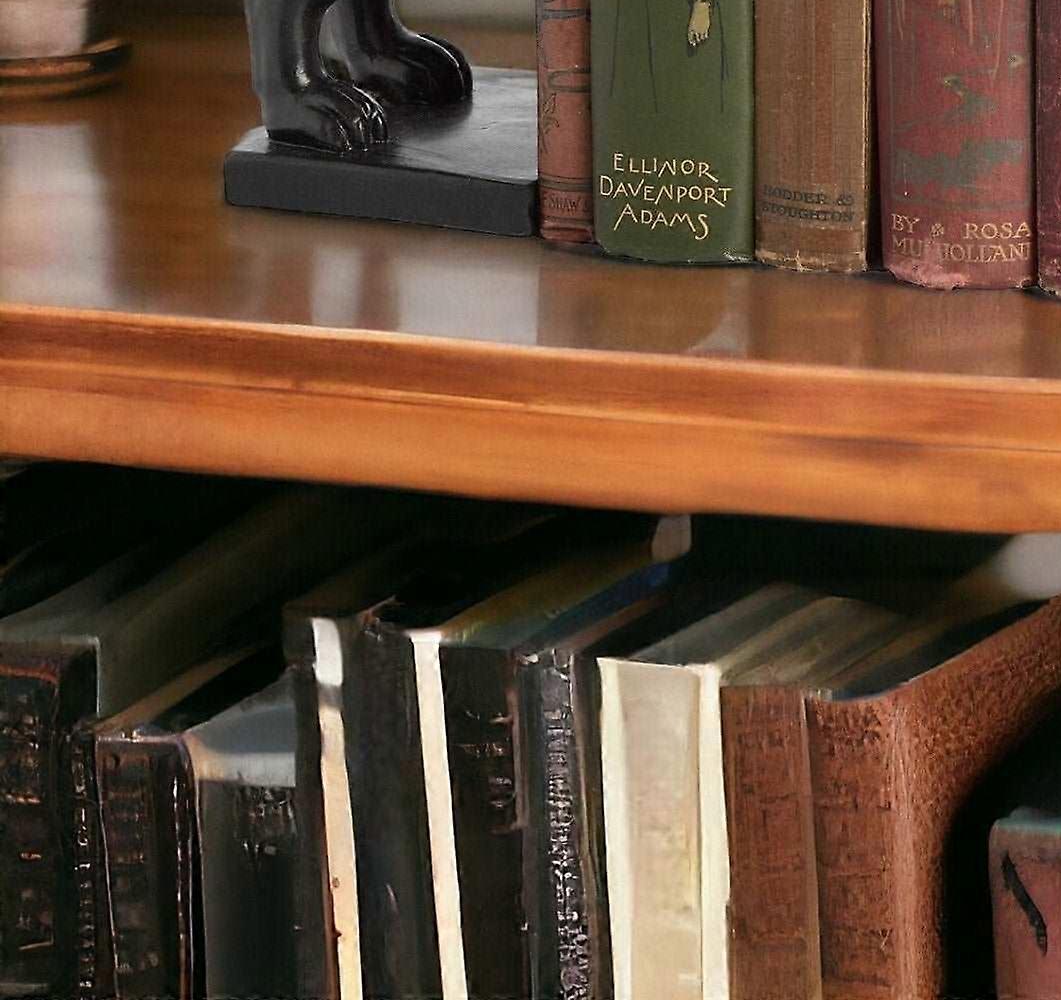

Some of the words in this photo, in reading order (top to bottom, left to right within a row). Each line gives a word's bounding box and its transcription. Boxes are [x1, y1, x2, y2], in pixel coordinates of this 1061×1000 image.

[613, 152, 719, 183] ELLINOR
[600, 174, 733, 207] DAVENPORT
[613, 203, 709, 240] ADAMS
[891, 213, 920, 234] BY
[963, 221, 1032, 240] ROSA
